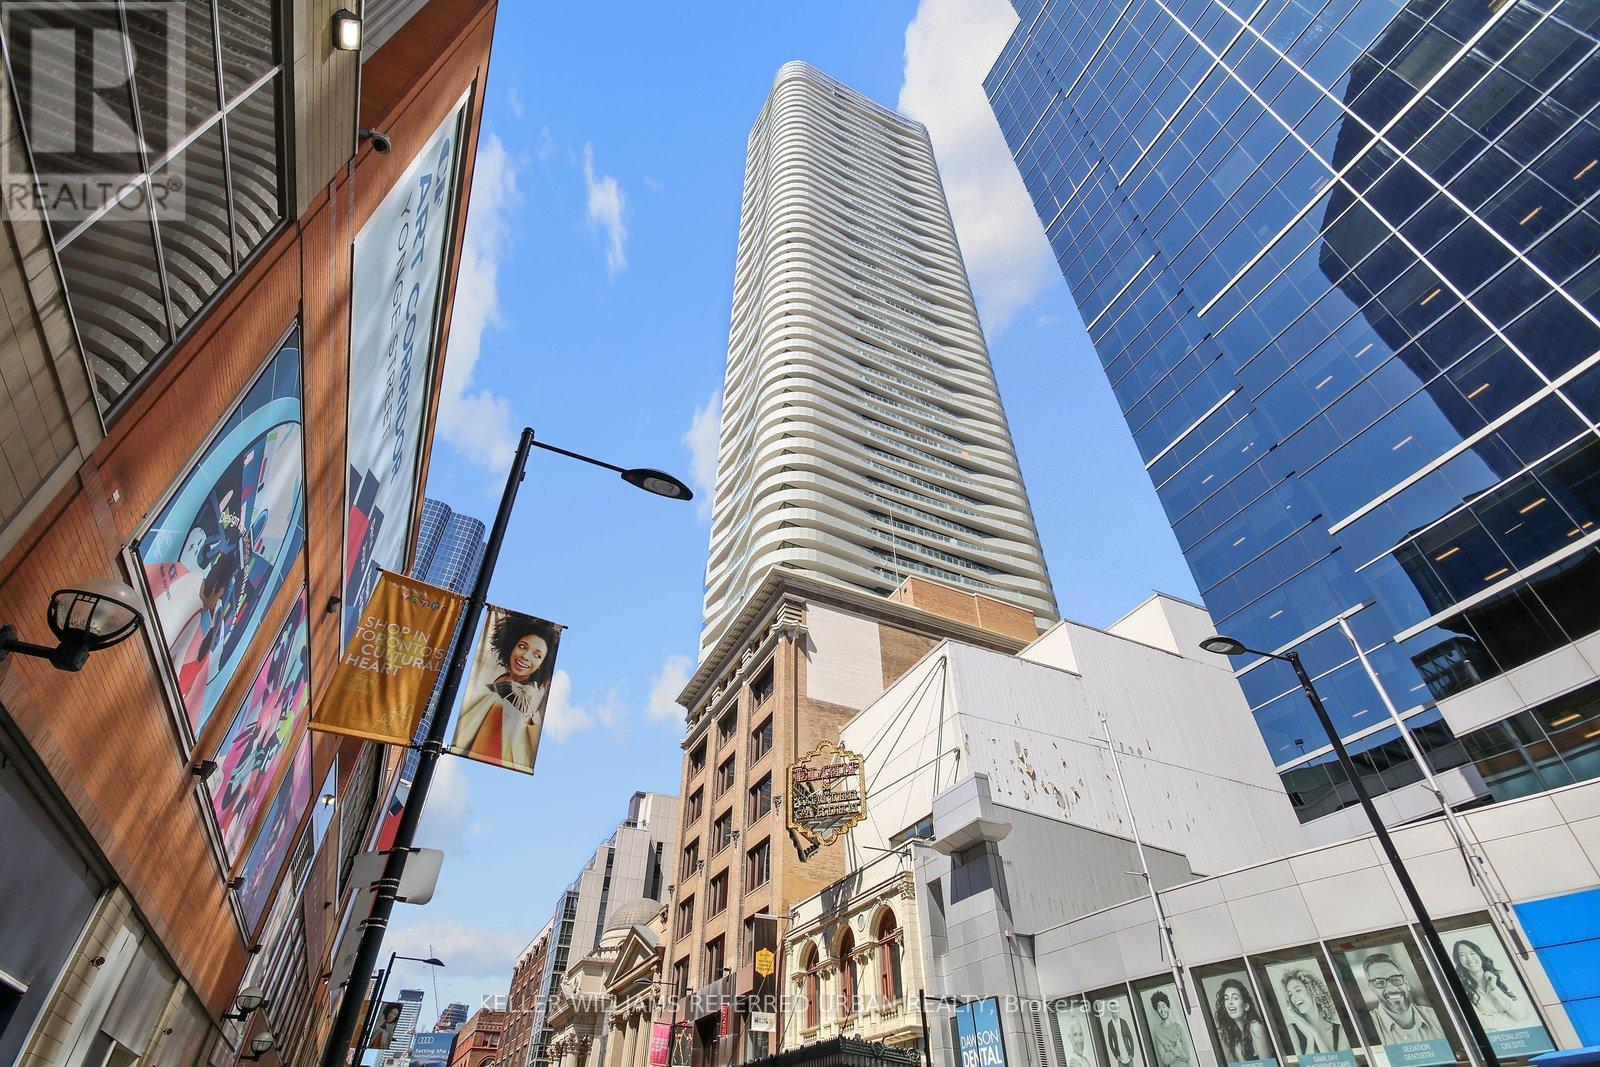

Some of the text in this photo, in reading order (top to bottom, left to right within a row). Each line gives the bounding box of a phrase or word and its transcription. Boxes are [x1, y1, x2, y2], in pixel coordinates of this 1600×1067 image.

[381, 191, 413, 440] YONGE STREET
[391, 172, 433, 484] ART CORRIDOR
[219, 511, 240, 527] Design
[365, 616, 431, 645] SHOP IN
[355, 626, 444, 659] TORONTO'S
[345, 653, 402, 677] HEART
[361, 643, 441, 672] CULTURAL
[960, 1029, 1000, 1049] DAWSON
[1402, 1043, 1431, 1053] SEDATION
[1489, 1031, 1530, 1043] SPECIALISTS
[962, 1045, 1003, 1067] DENTAL
[1403, 1051, 1436, 1061] DENTISTRY
